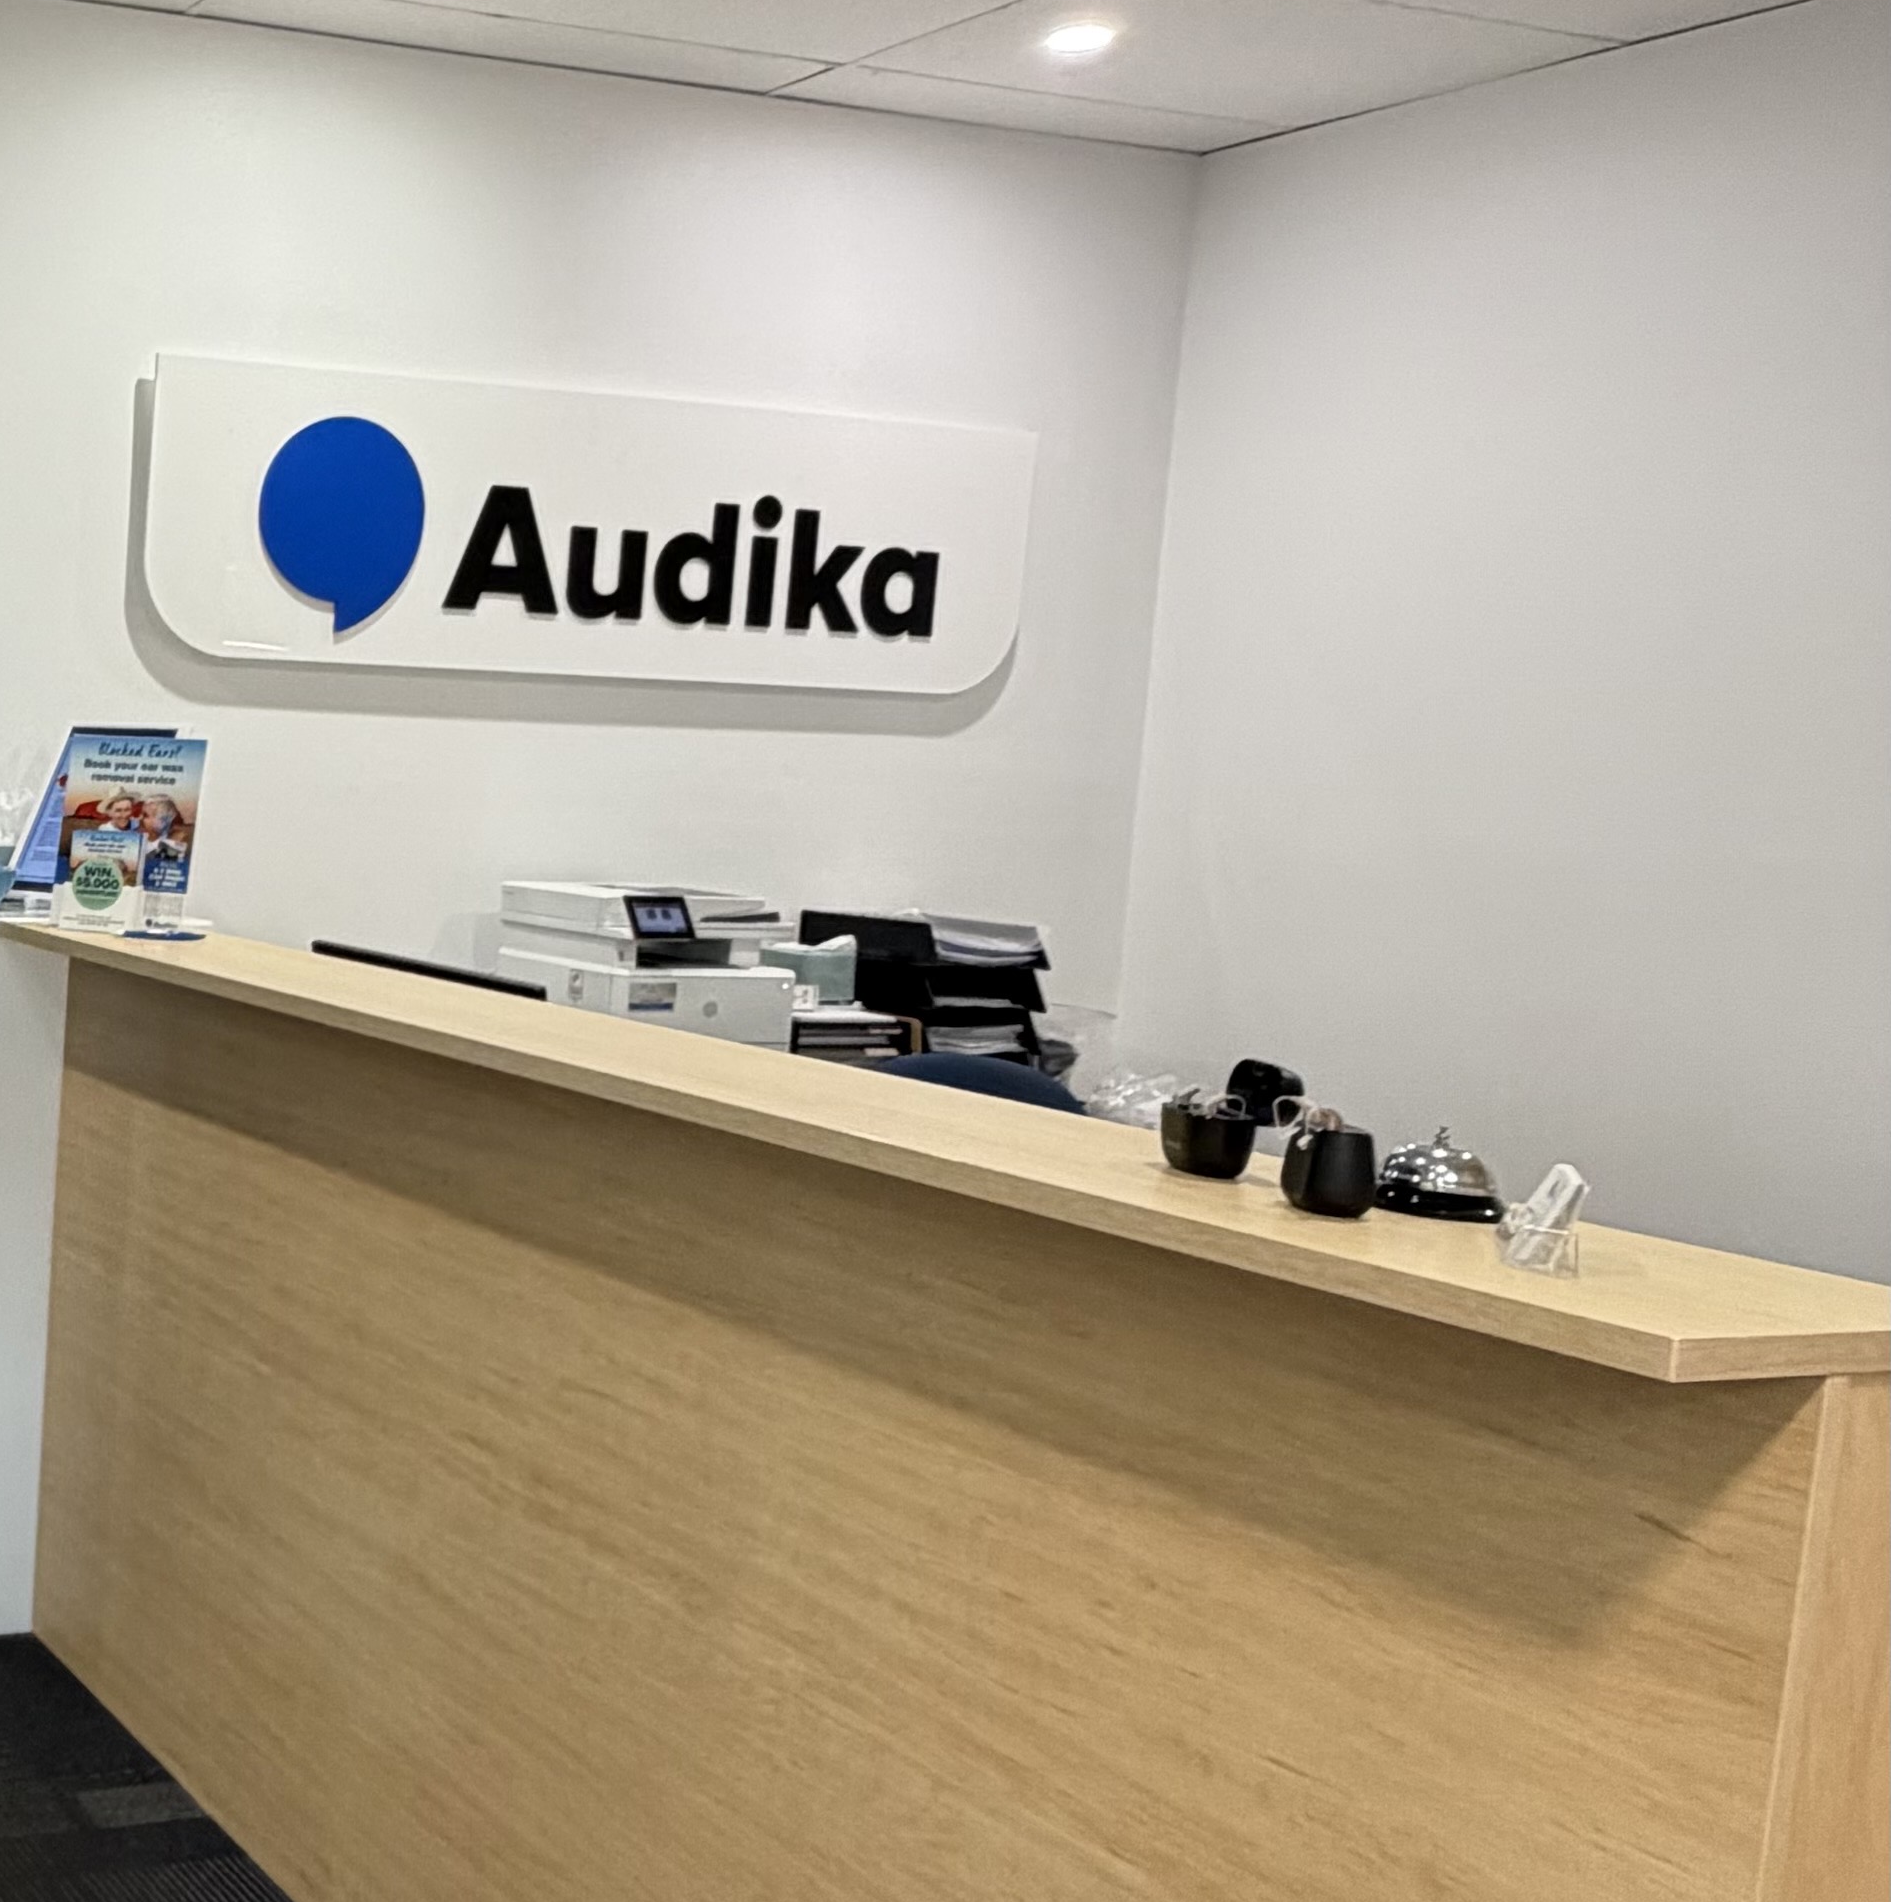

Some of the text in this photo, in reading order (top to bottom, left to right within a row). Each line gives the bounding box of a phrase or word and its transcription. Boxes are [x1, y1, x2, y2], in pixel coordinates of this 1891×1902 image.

[441, 484, 940, 638] Audika
[98, 741, 144, 757] Blocked
[84, 759, 184, 772] Book your ear wax
[91, 773, 176, 785] removal service
